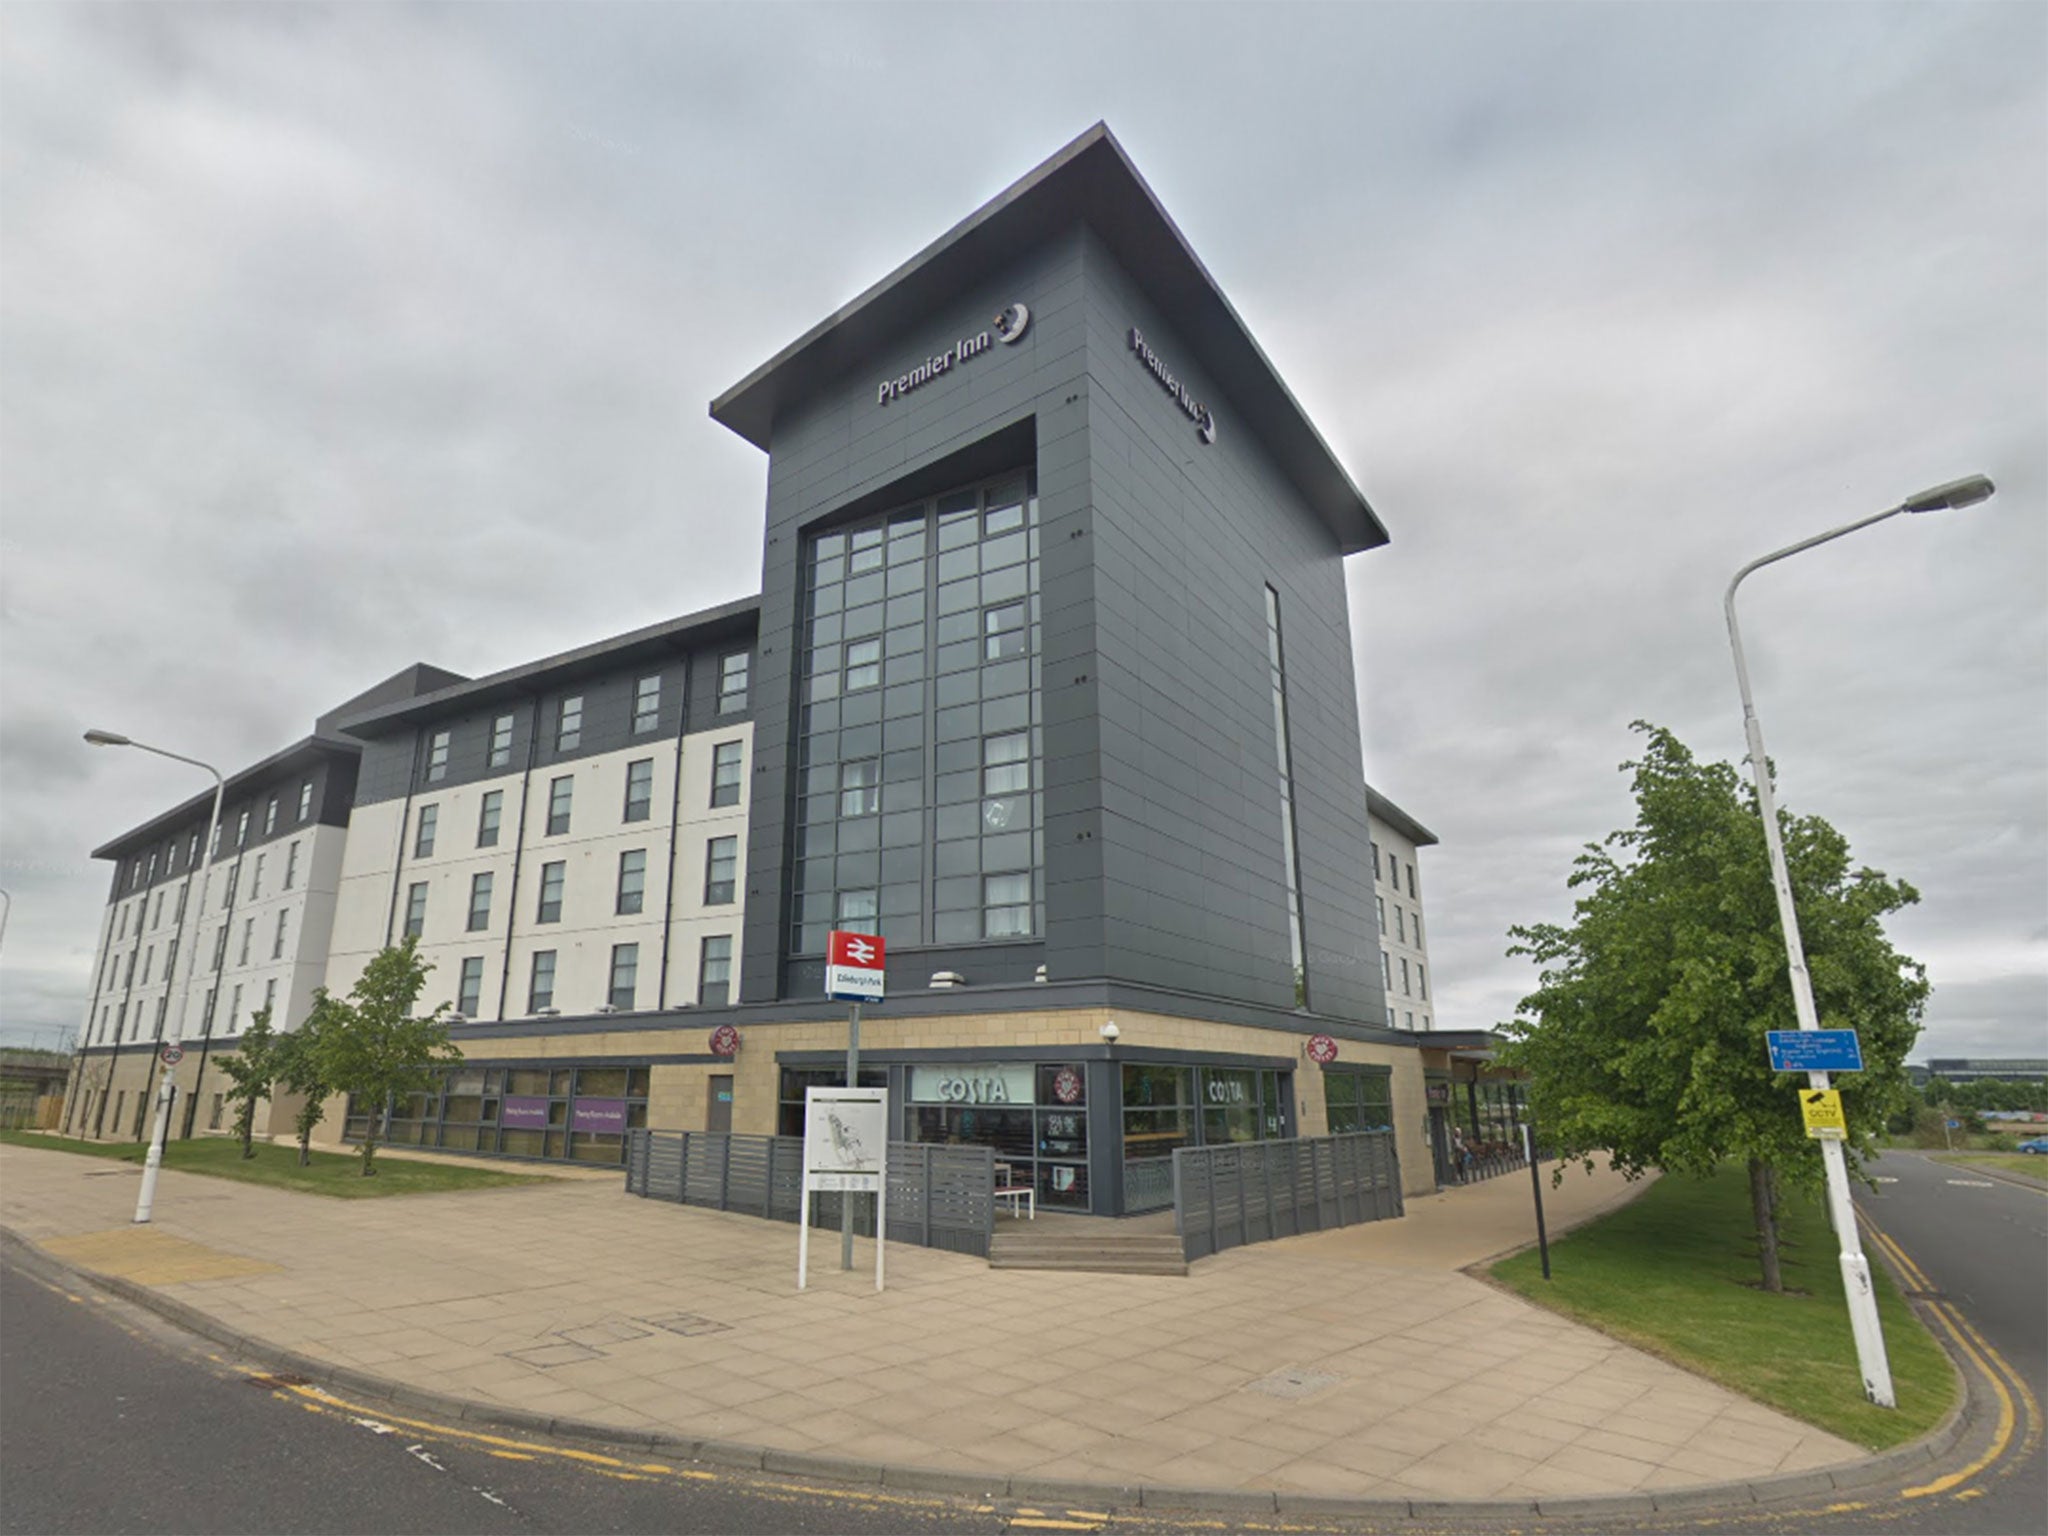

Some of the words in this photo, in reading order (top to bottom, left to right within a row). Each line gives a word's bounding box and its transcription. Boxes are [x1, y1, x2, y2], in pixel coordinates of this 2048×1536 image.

[878, 349, 953, 404] Premier
[956, 331, 990, 361] Inn
[1133, 326, 1181, 396] Premier
[937, 1077, 1008, 1105] COSTA
[1208, 1080, 1244, 1104] COSTA
